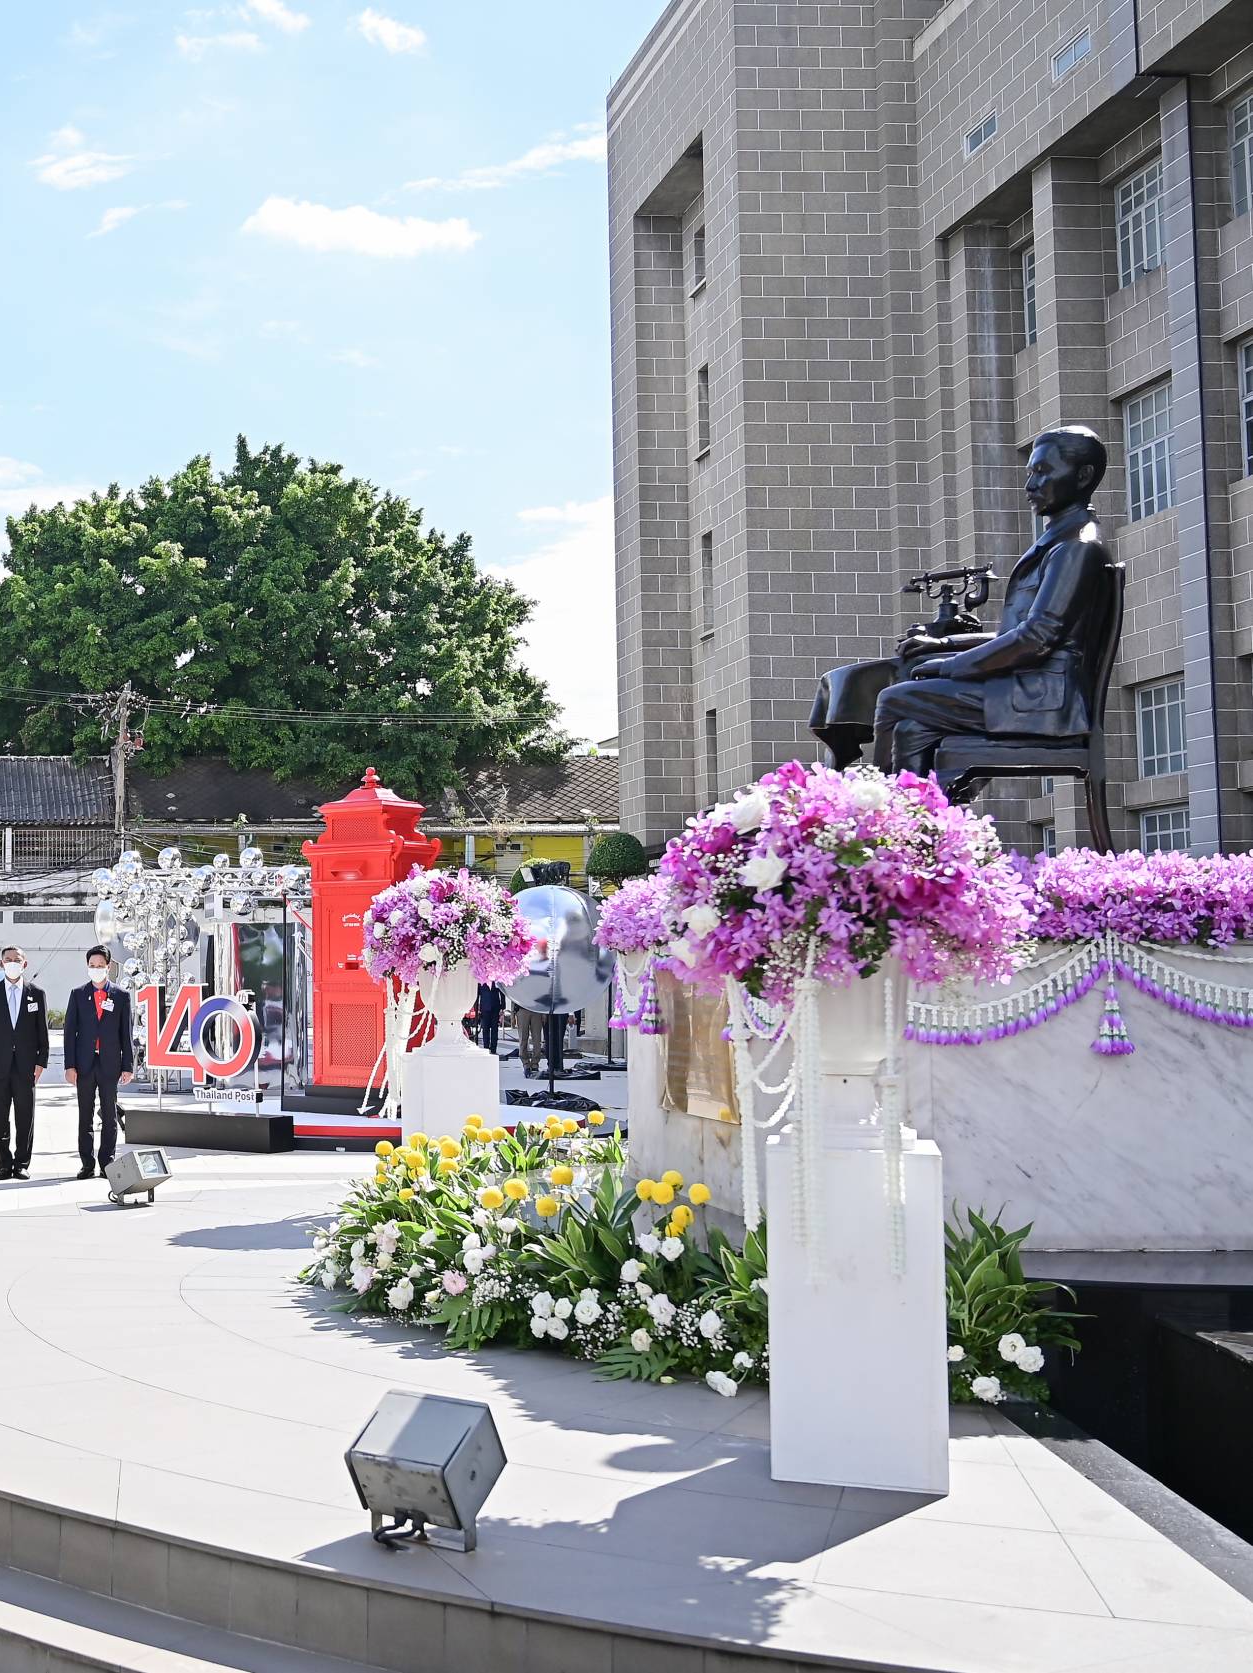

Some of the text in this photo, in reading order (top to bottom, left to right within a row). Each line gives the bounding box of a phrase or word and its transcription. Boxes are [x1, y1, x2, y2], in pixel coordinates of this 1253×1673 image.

[135, 983, 255, 1085] 140
[194, 1089, 256, 1101] Thailand Post
